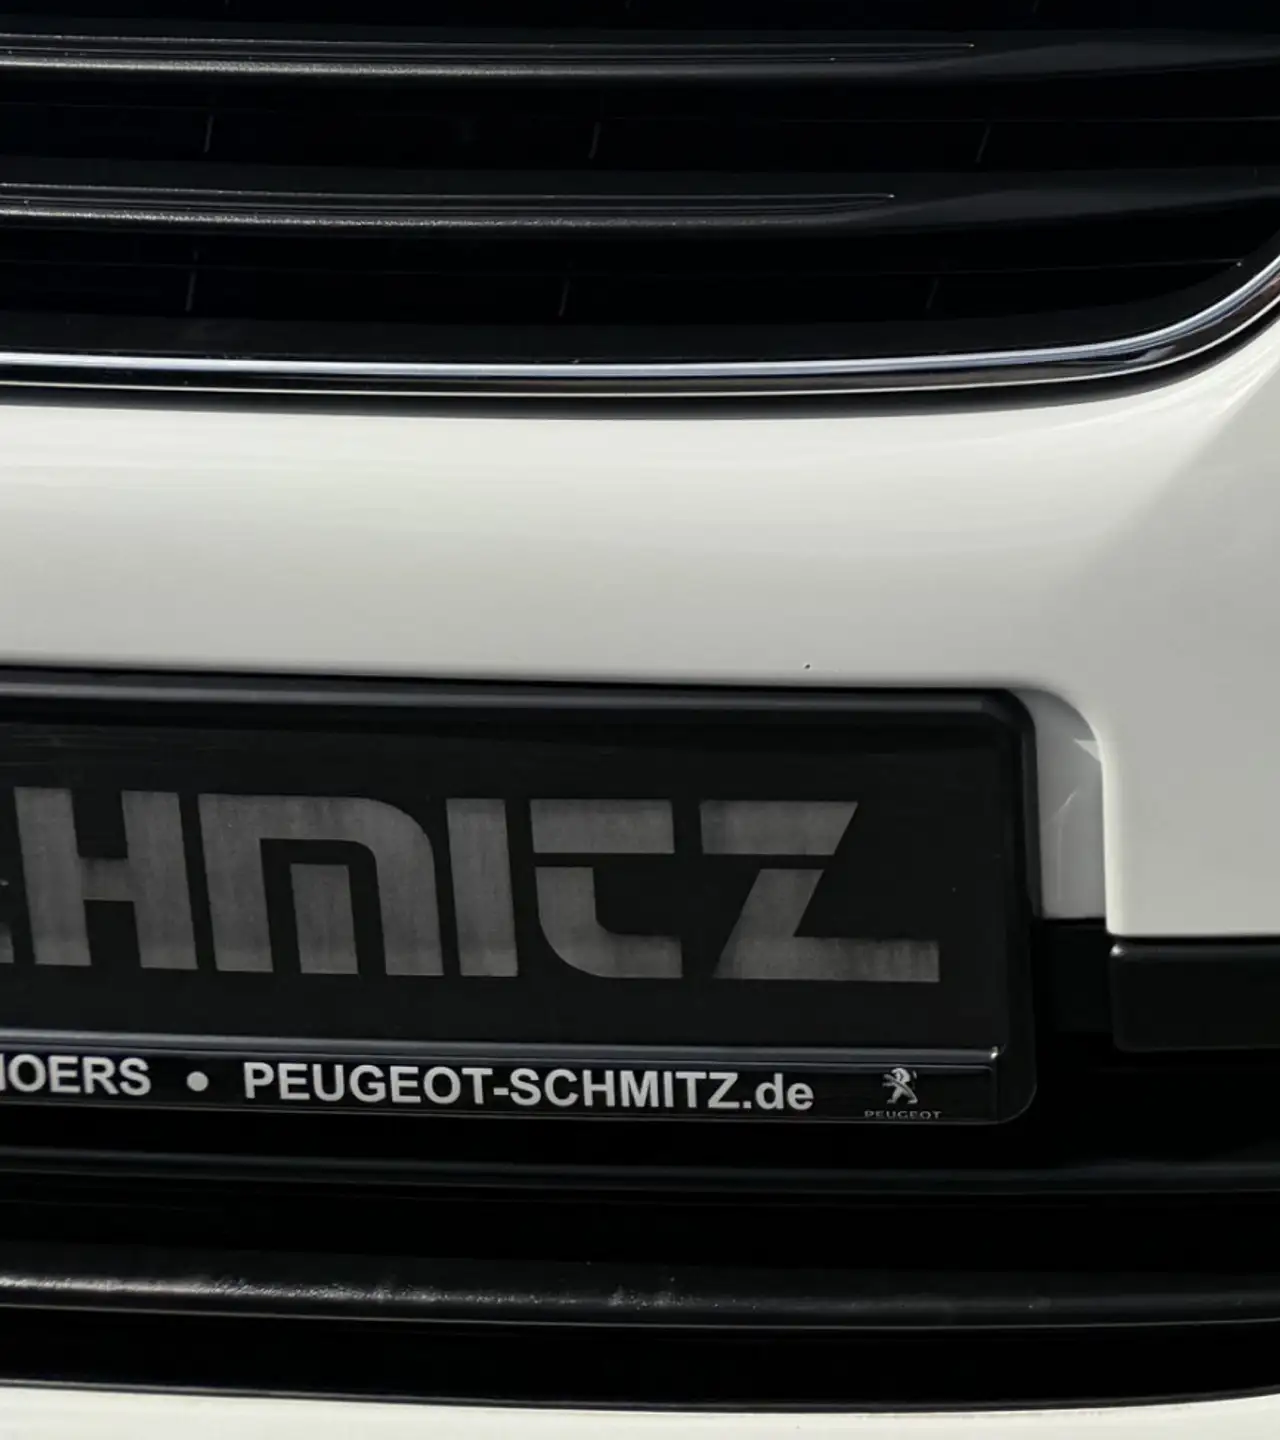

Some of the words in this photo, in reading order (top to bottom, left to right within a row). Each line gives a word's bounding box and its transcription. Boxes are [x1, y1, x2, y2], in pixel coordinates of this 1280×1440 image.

[0, 786, 940, 983] HMITZ
[0, 1053, 152, 1096] OERS
[243, 1061, 815, 1111] PEUGEOT-SCHMITZ.de
[864, 1109, 942, 1121] PEUGEOT
